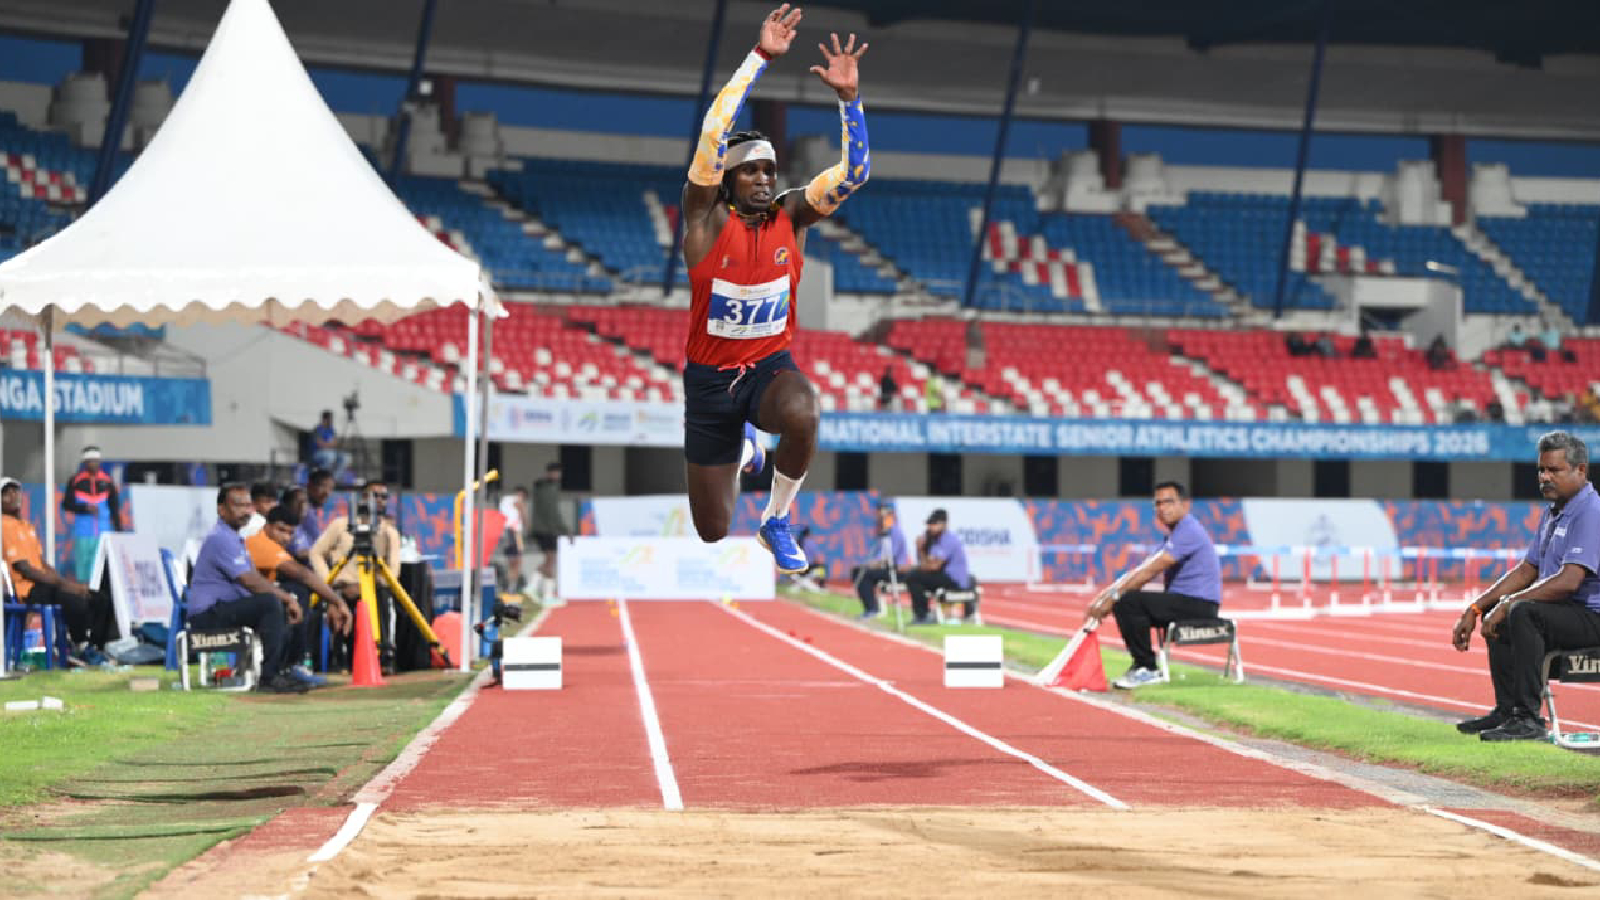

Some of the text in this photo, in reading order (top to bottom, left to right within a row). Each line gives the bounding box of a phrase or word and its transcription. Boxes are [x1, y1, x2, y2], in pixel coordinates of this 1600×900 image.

[724, 297, 780, 324] 377
[50, 379, 144, 416] STADIUM
[820, 418, 925, 444] NATIONAL
[927, 421, 1050, 448] INTERSTATE
[1056, 424, 1132, 449] SENIOR
[1135, 425, 1249, 450] ATHLETICS
[1251, 427, 1428, 453] CHAMPIONSHIPS
